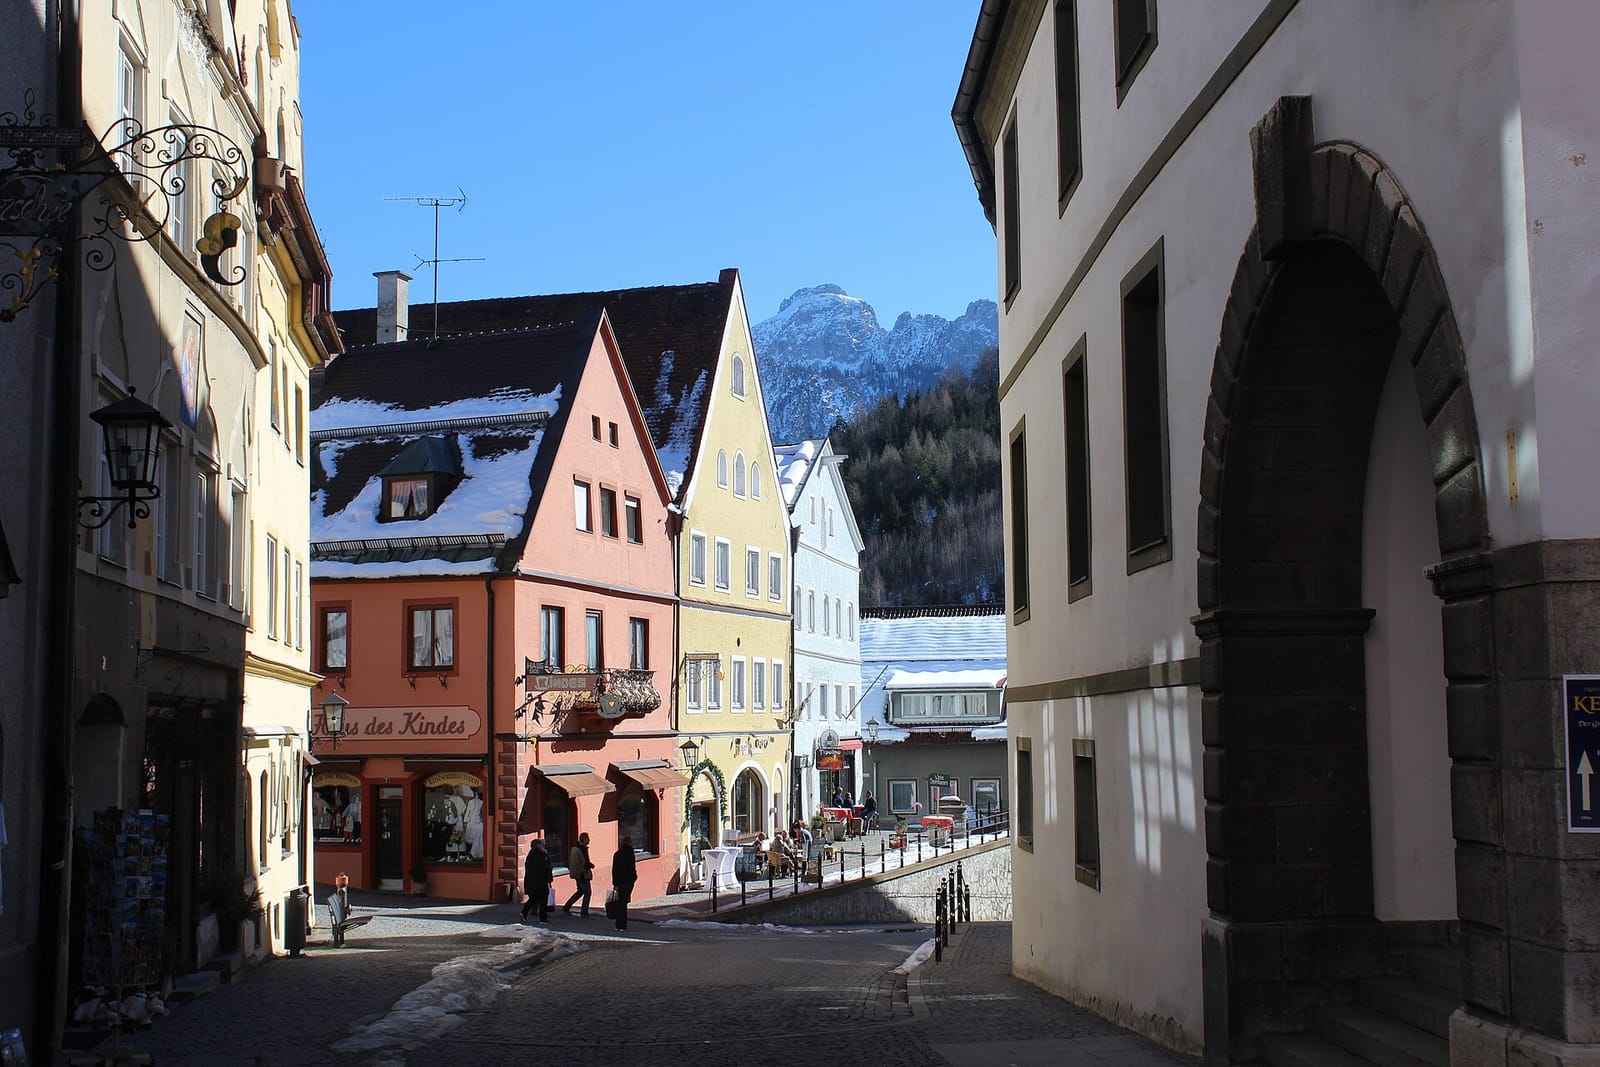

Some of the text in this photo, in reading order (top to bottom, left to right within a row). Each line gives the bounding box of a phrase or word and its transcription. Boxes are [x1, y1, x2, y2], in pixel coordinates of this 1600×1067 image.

[312, 711, 465, 735] Hs des Kindes
